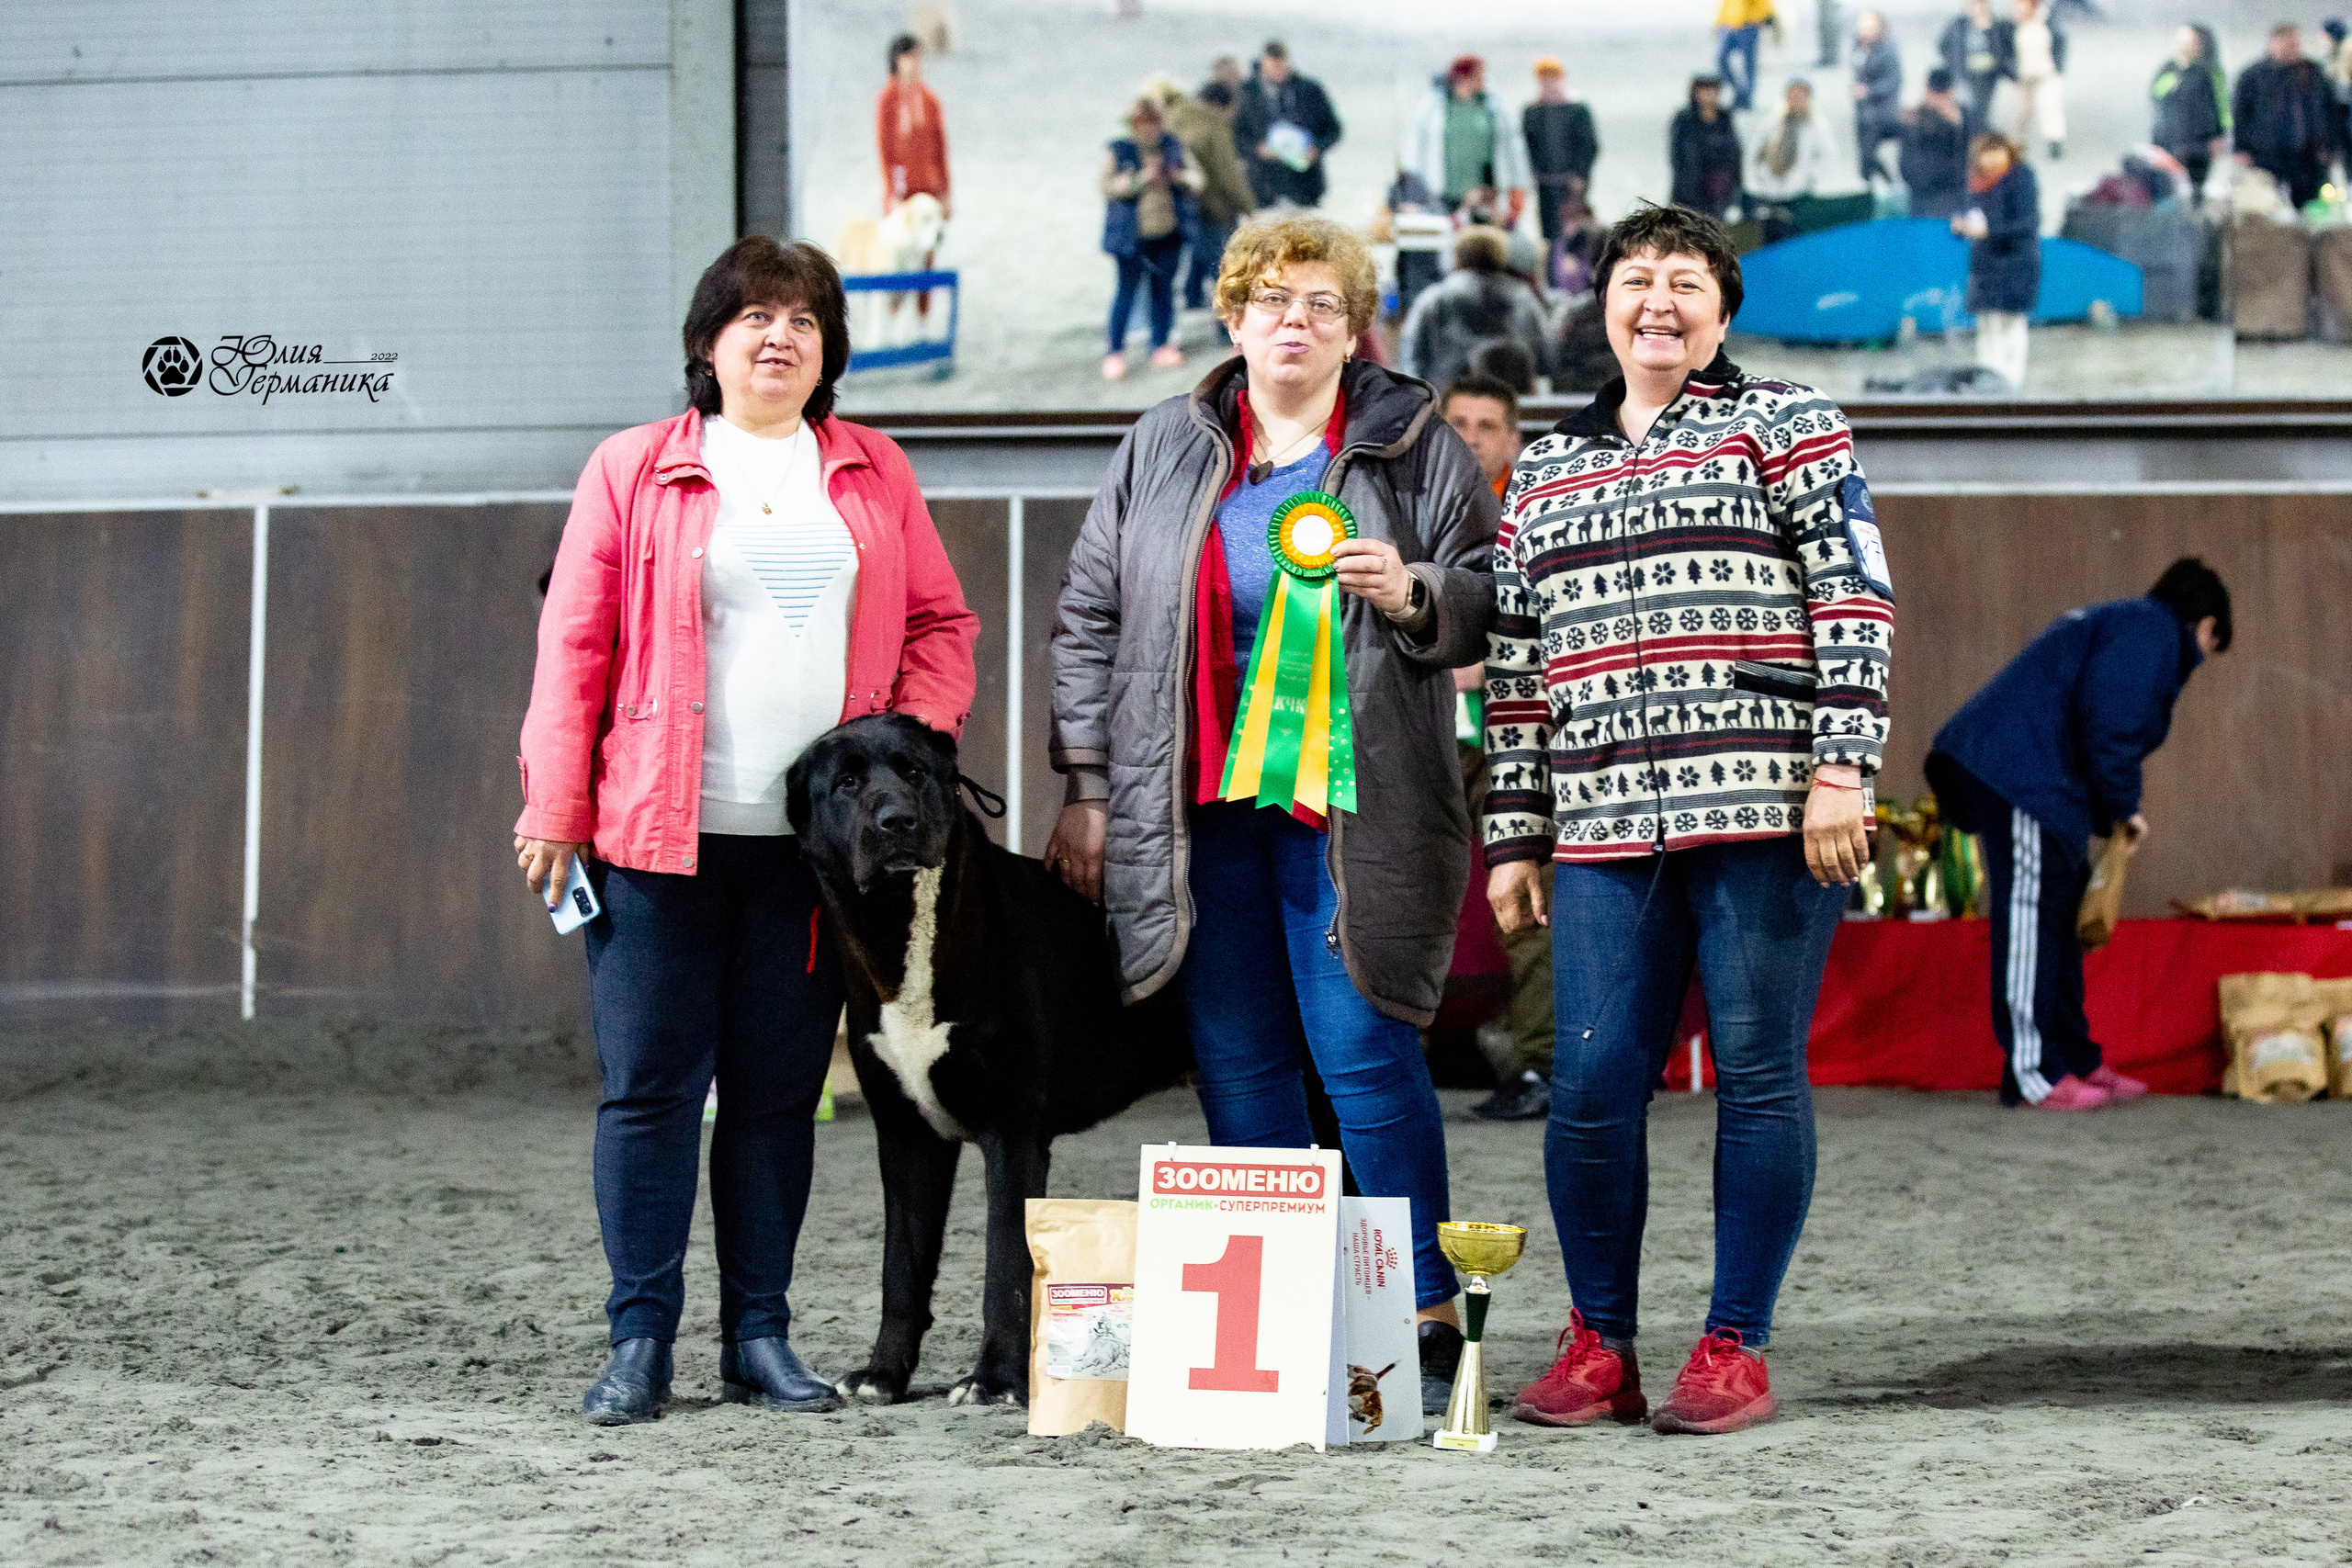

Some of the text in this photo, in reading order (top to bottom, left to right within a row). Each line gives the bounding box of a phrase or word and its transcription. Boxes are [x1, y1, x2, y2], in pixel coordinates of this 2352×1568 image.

[1157, 1166, 1321, 1194] ЗООМЕНЮ
[1360, 1218, 1369, 1254] ЗДОРОВЬЕ
[1353, 1255, 1362, 1286] СТРАСТЬ
[1363, 1256, 1372, 1295] ПИТОМЦЕВ
[1374, 1229, 1385, 1288] ROYAL CANIN
[1051, 1289, 1104, 1298] ЗООМЕНЮ
[1182, 1235, 1280, 1393] 1
